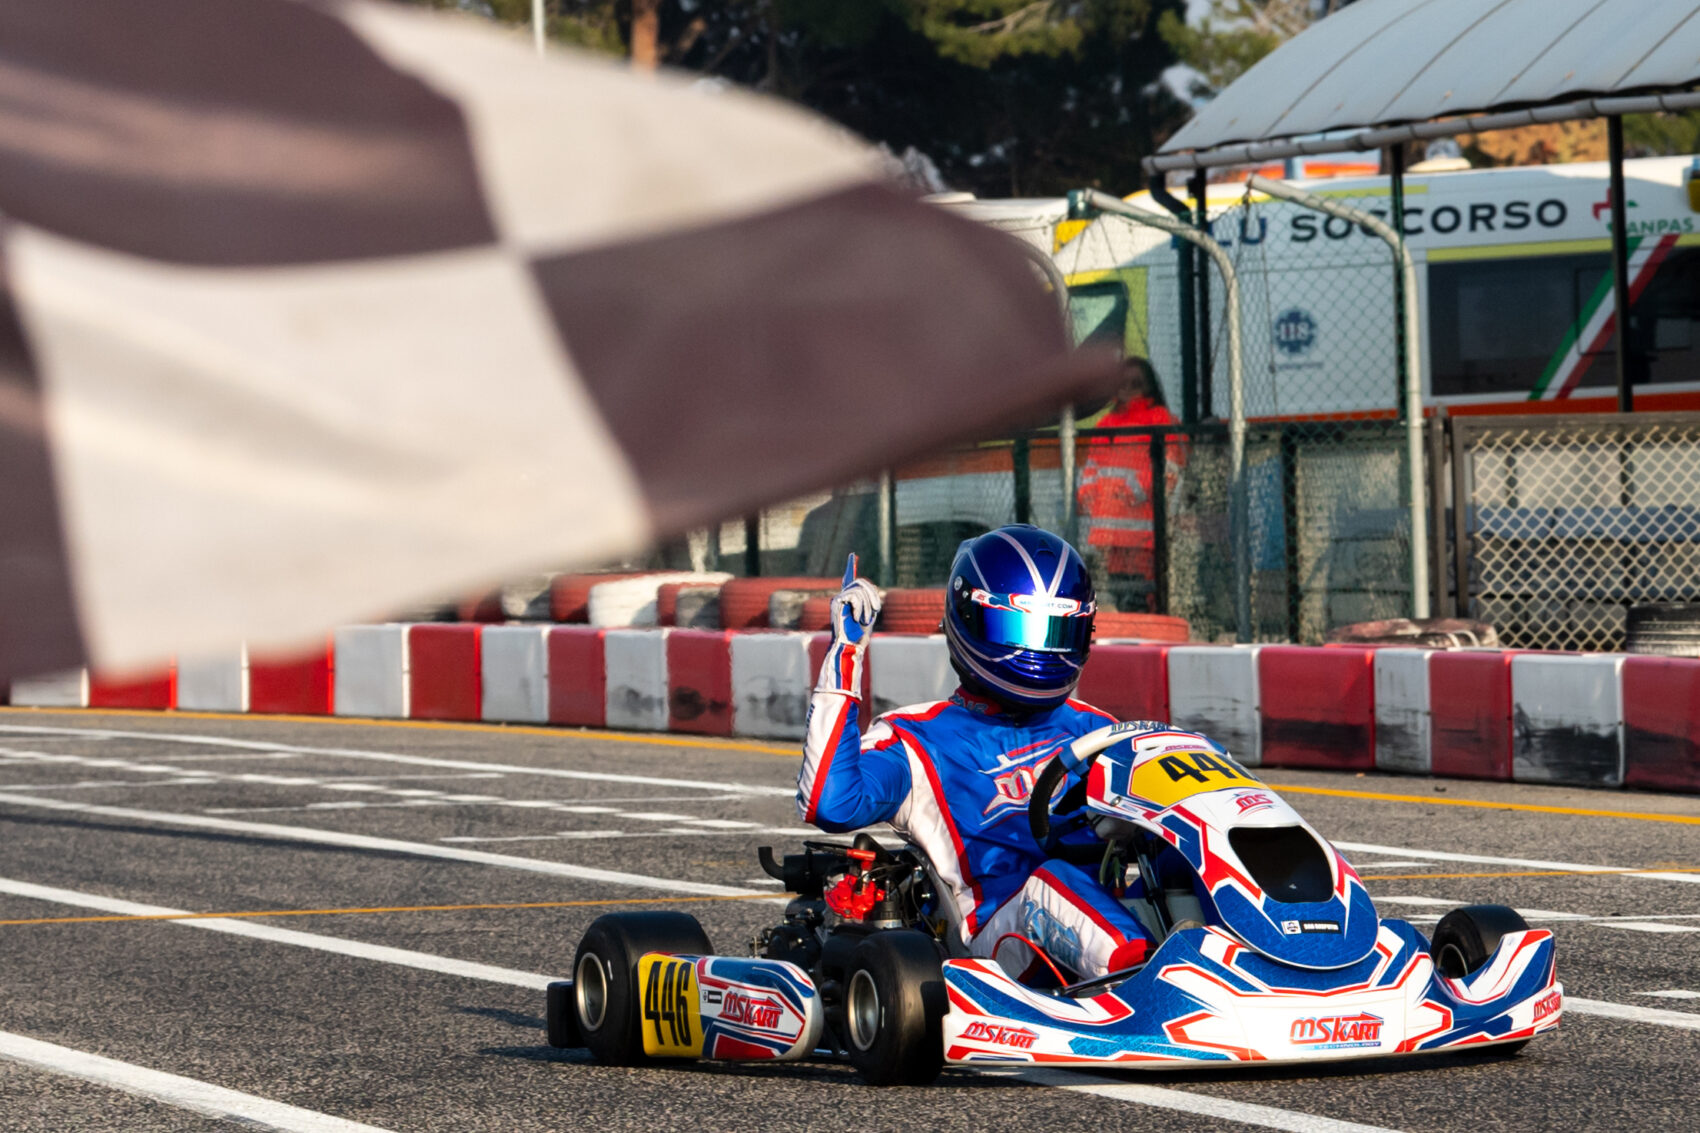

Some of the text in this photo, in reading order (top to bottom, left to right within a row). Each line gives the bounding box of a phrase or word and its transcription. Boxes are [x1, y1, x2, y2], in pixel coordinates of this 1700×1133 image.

[1171, 199, 1568, 250] LU SOCCORSO
[1626, 217, 1694, 234] ANPAS
[645, 961, 692, 1048] 446
[957, 1021, 1040, 1049] MSKART
[1289, 1013, 1384, 1044] MSKART
